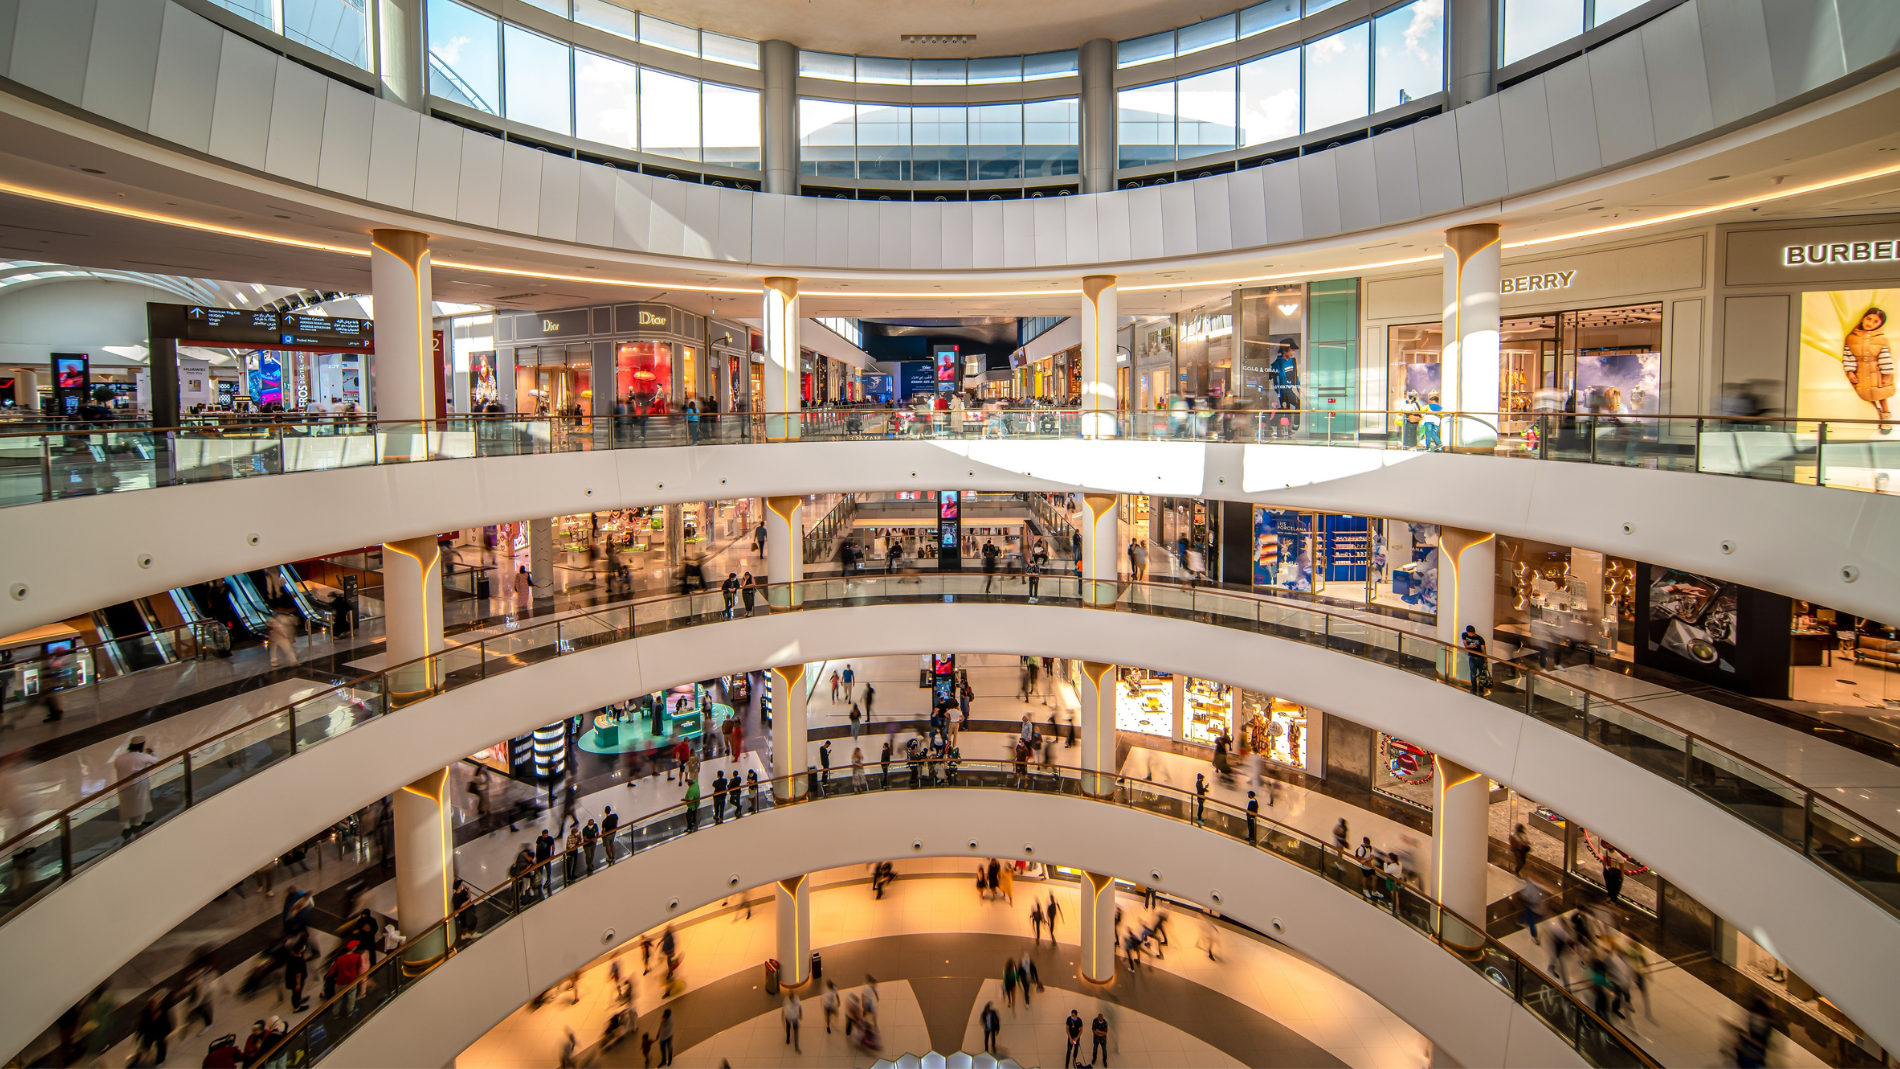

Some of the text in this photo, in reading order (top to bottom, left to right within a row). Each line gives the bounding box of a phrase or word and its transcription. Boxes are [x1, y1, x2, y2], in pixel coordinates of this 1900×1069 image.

[1500, 269, 1577, 294] BERRY
[543, 320, 559, 332] Dior
[638, 311, 666, 326] Dior
